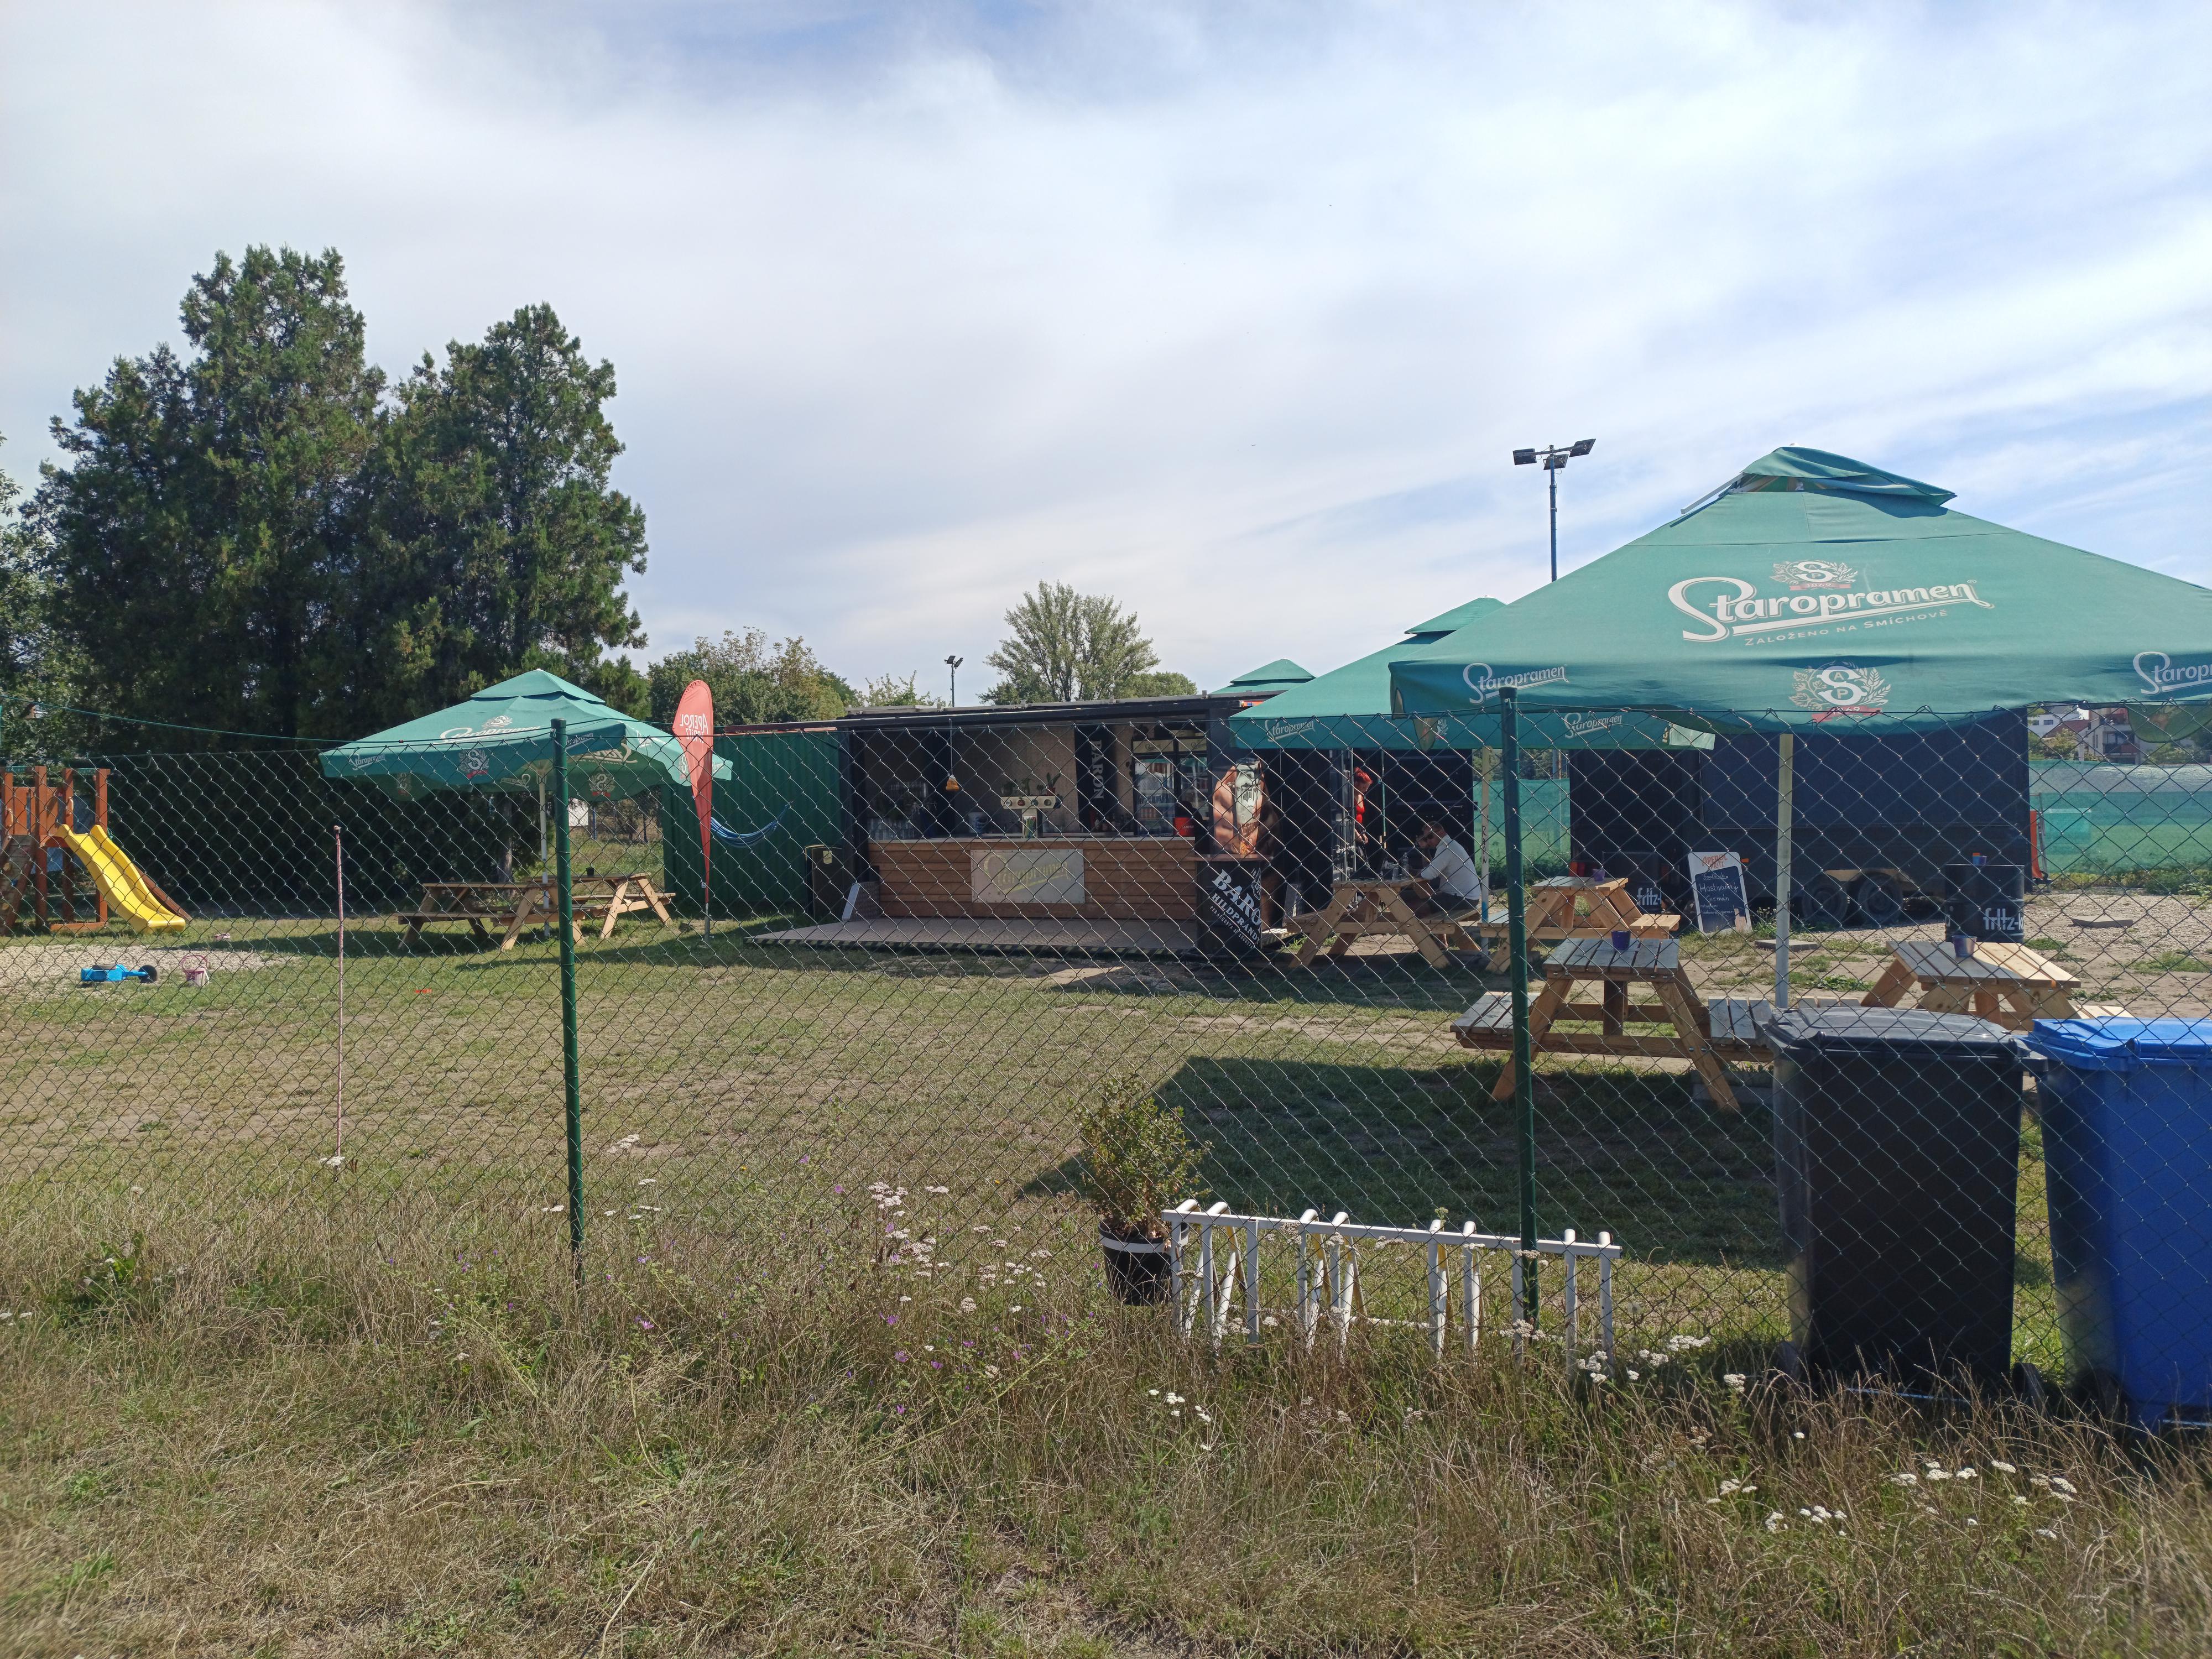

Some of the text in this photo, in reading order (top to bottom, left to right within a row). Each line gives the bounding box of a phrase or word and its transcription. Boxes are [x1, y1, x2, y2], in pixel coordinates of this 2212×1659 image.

[1668, 576, 1995, 642] Staropramen
[1744, 629, 1829, 646] ZALOŽENO
[1863, 609, 1948, 629] SMÍCHOVĚ
[1463, 662, 1569, 705] Staropramen
[1264, 719, 1316, 742] Staropramen
